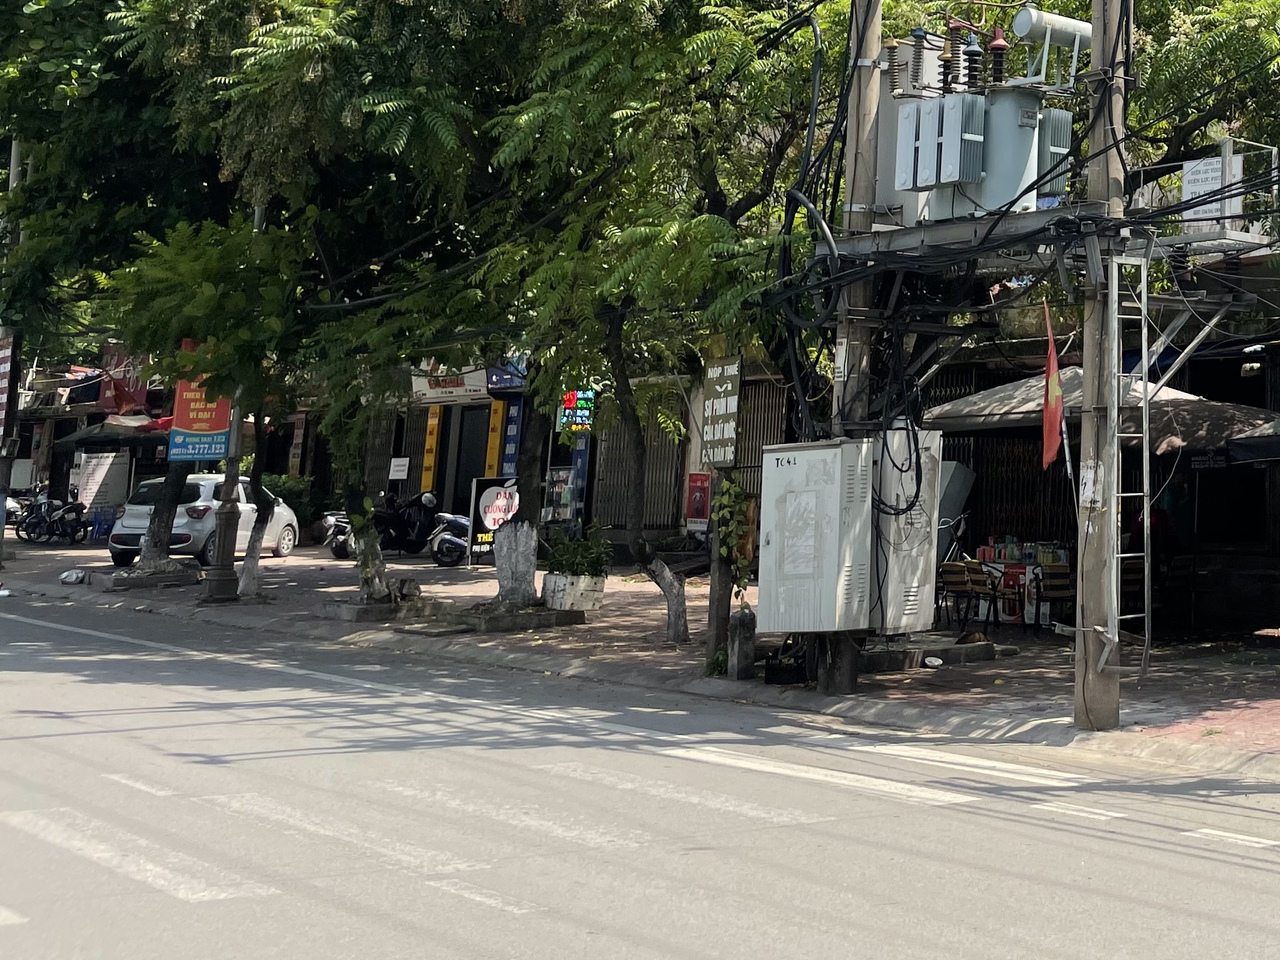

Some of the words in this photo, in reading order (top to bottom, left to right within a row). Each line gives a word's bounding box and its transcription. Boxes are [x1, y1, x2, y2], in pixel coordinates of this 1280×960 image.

[707, 364, 722, 380] NỘP
[723, 360, 739, 376] THUẾ
[496, 489, 514, 500] DÁN
